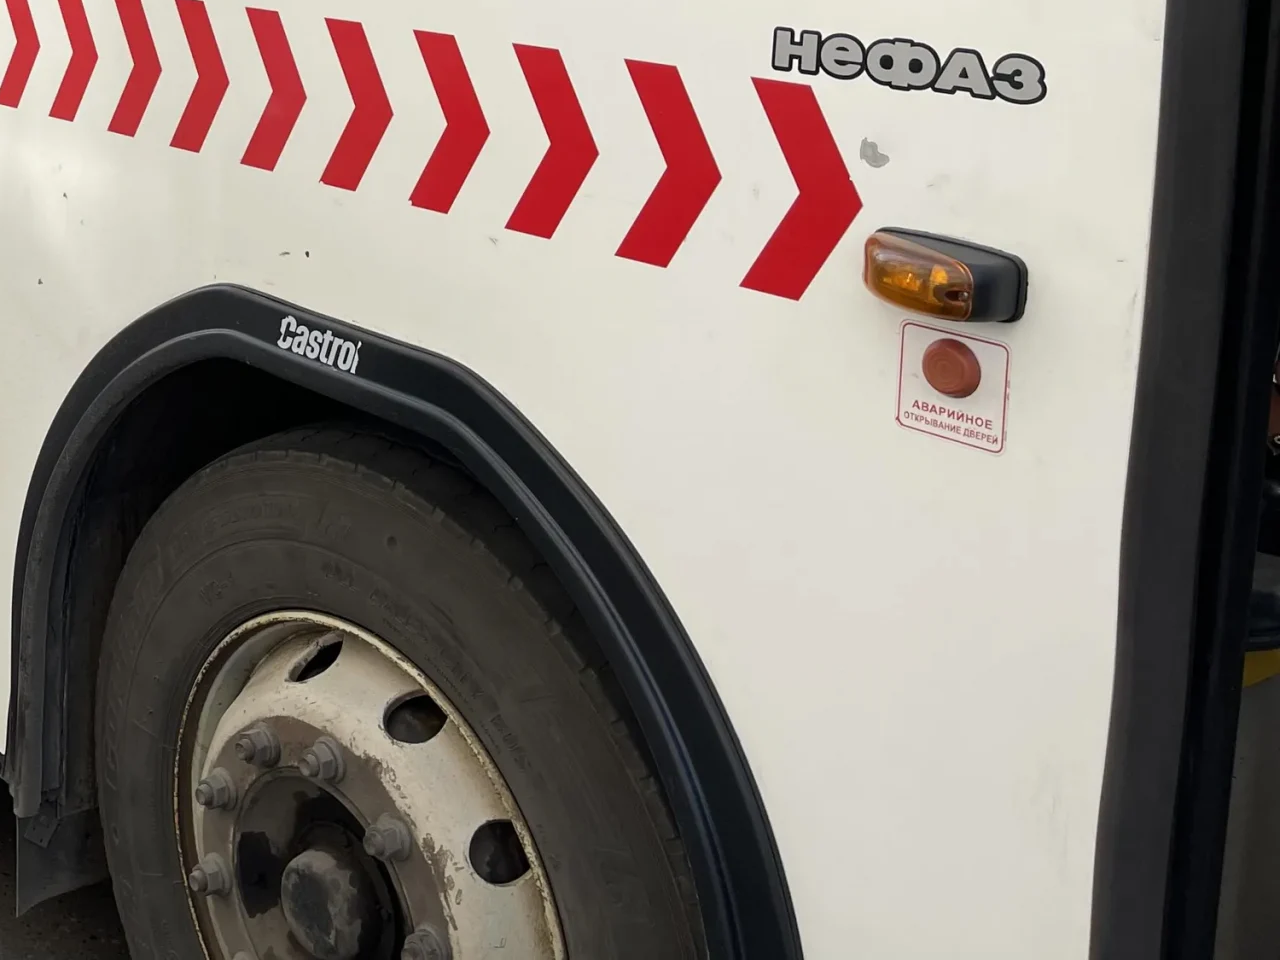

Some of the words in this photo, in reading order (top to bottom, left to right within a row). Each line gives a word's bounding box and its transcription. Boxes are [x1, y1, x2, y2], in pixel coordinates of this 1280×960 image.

[903, 410, 962, 436] ОТКРЫВАНИЕ
[962, 427, 999, 446] ДВЕРЕЙ
[911, 399, 994, 431] АВАРИЙНОЕ
